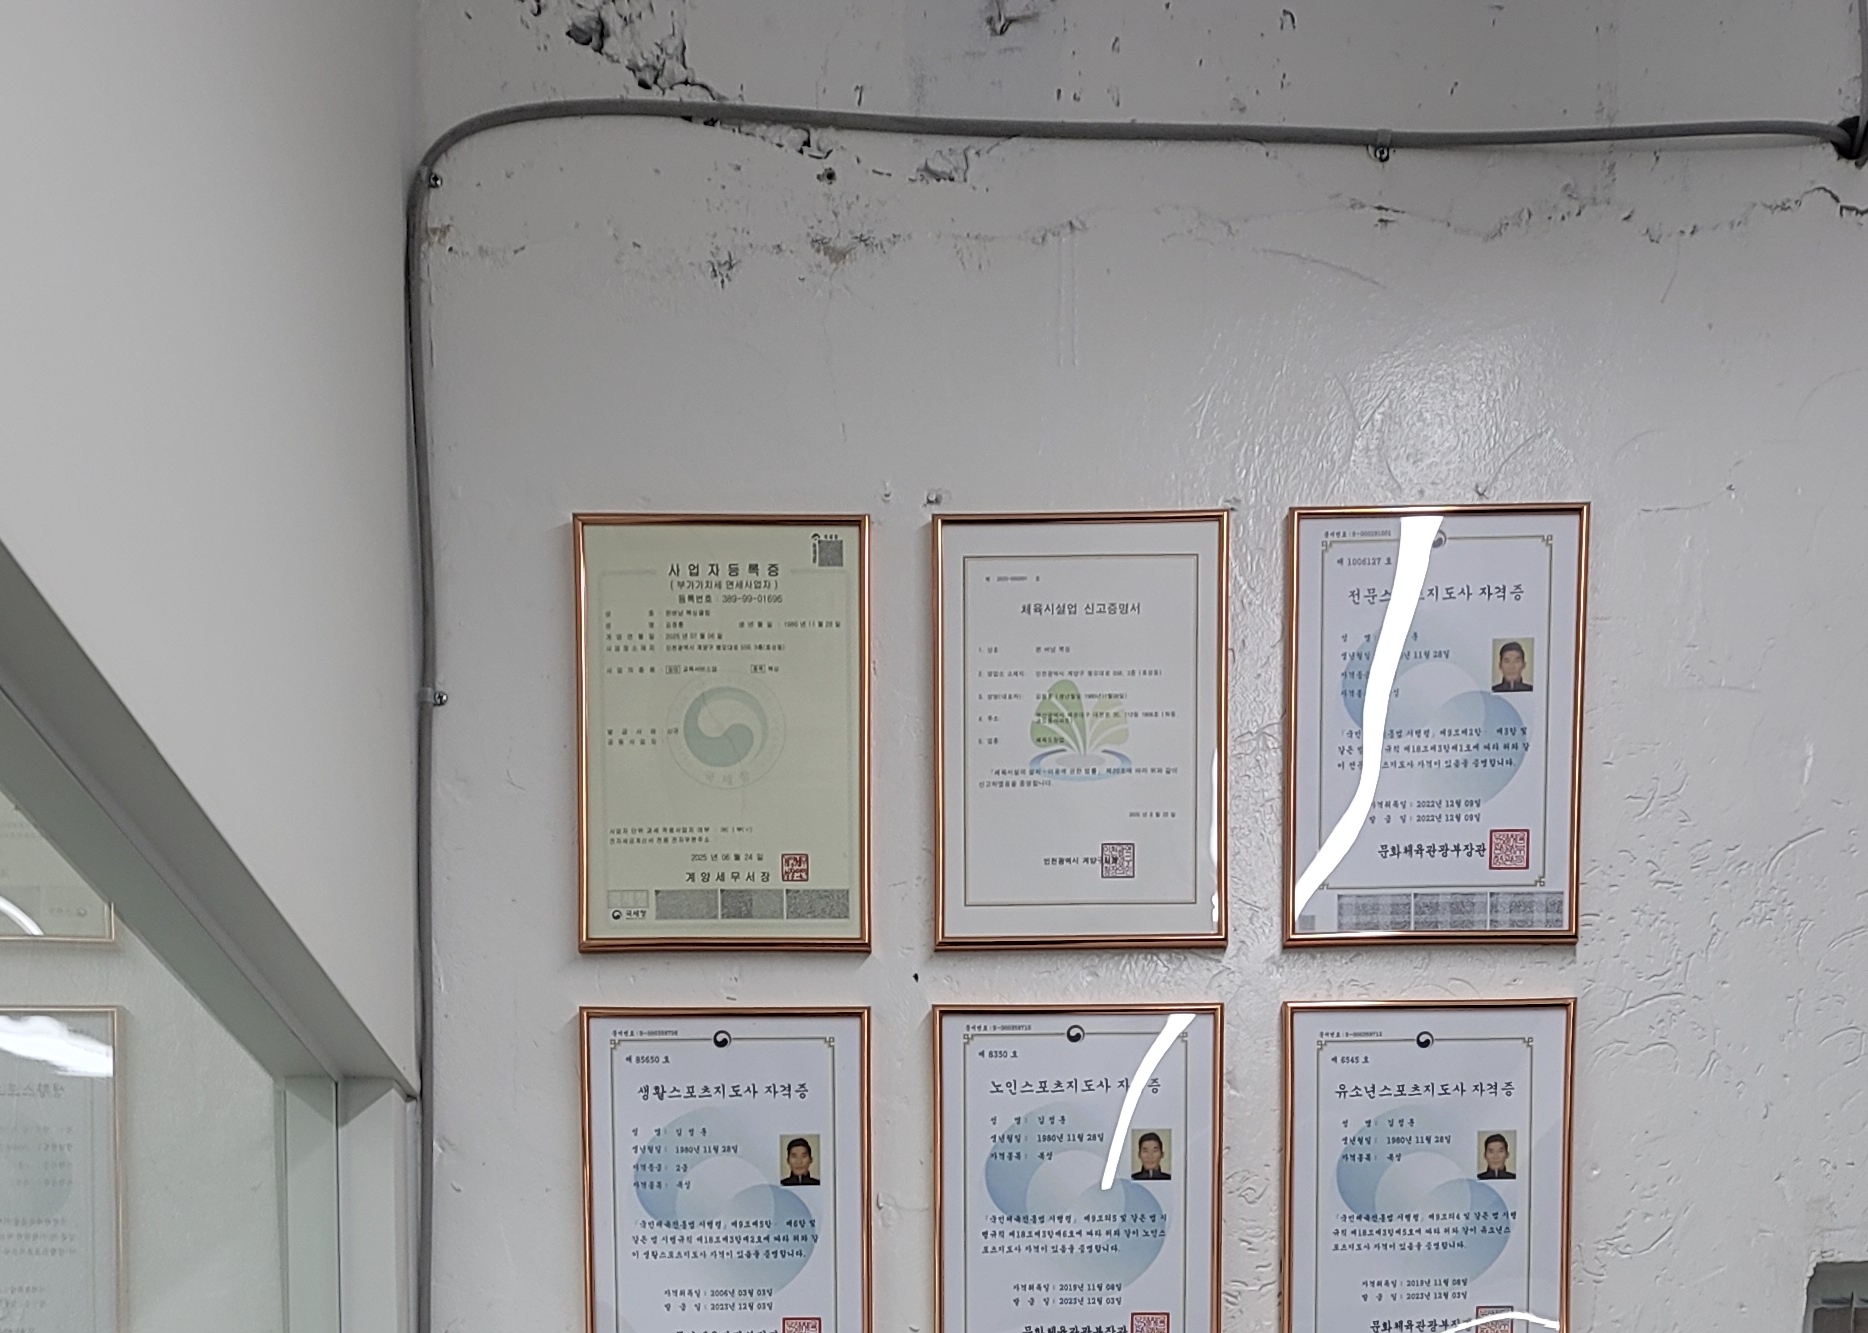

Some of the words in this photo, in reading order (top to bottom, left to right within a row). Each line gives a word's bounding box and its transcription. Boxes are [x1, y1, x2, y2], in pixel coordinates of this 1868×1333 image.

[1478, 583, 1525, 601] 자격증
[637, 1083, 759, 1101] 생활스포츠지도사
[764, 1082, 809, 1100] 자격증
[989, 1077, 1112, 1096] 노인스포츠지도사
[1116, 1076, 1161, 1095] 자증
[1334, 1081, 1467, 1100] 유소년스포츠지도사
[1472, 1081, 1516, 1098] 자격증
